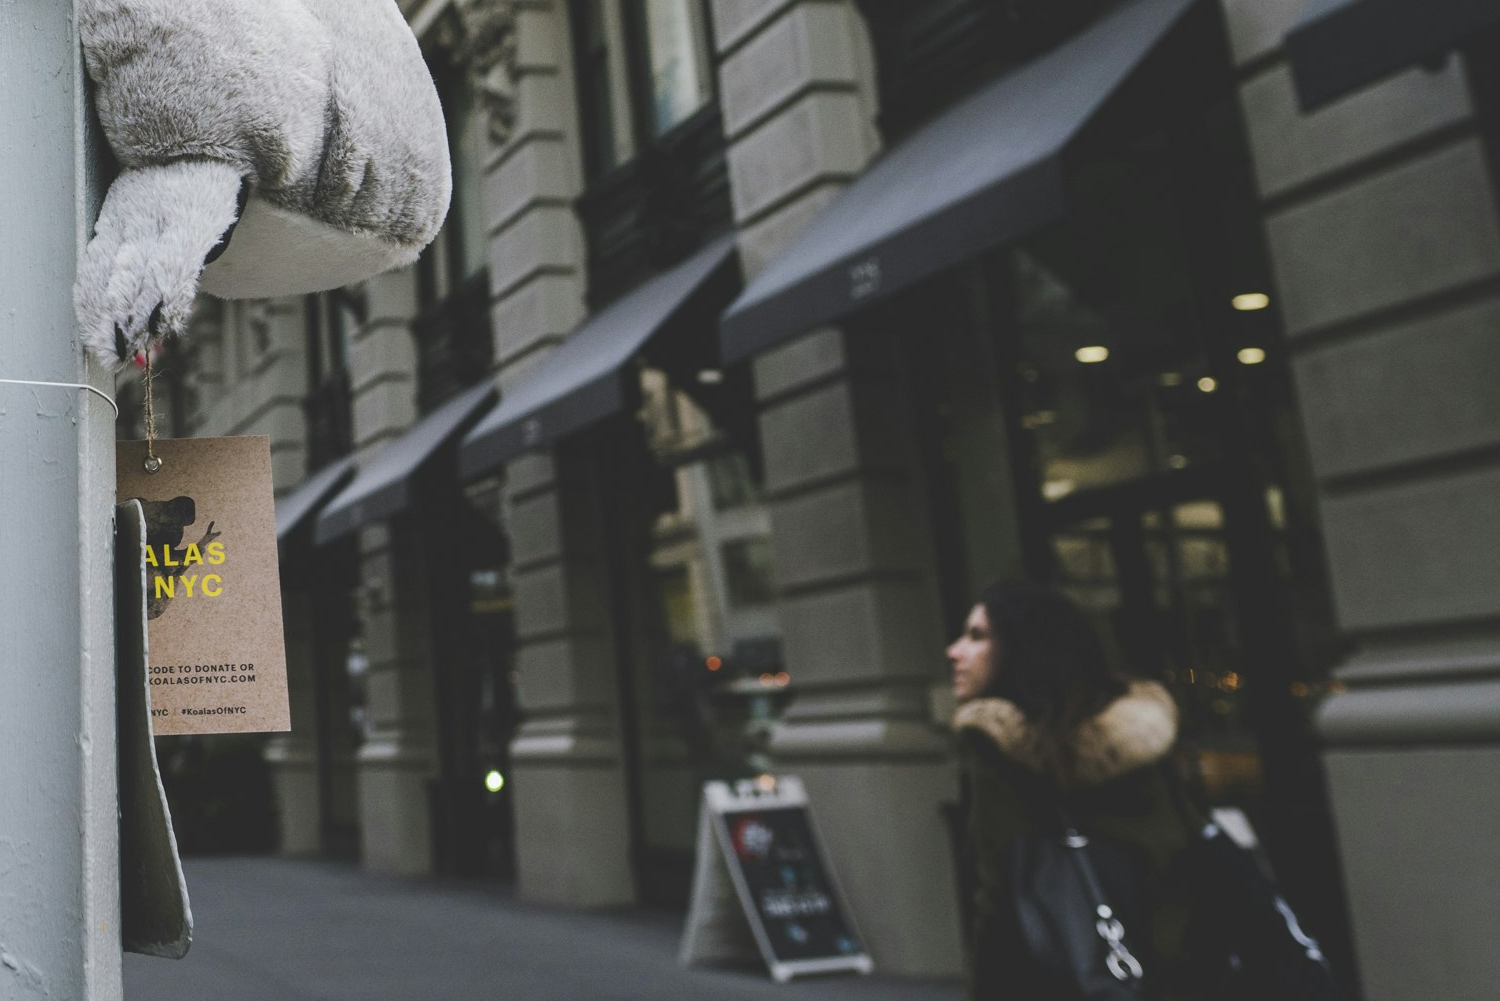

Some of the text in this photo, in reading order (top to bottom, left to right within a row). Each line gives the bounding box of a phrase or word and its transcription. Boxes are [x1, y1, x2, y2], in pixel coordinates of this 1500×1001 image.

[155, 573, 223, 599] NYC
[178, 665, 192, 674] TO
[195, 664, 237, 673] DONATE
[240, 663, 255, 672] OR
[181, 706, 247, 716] #KoalasOfNYC
